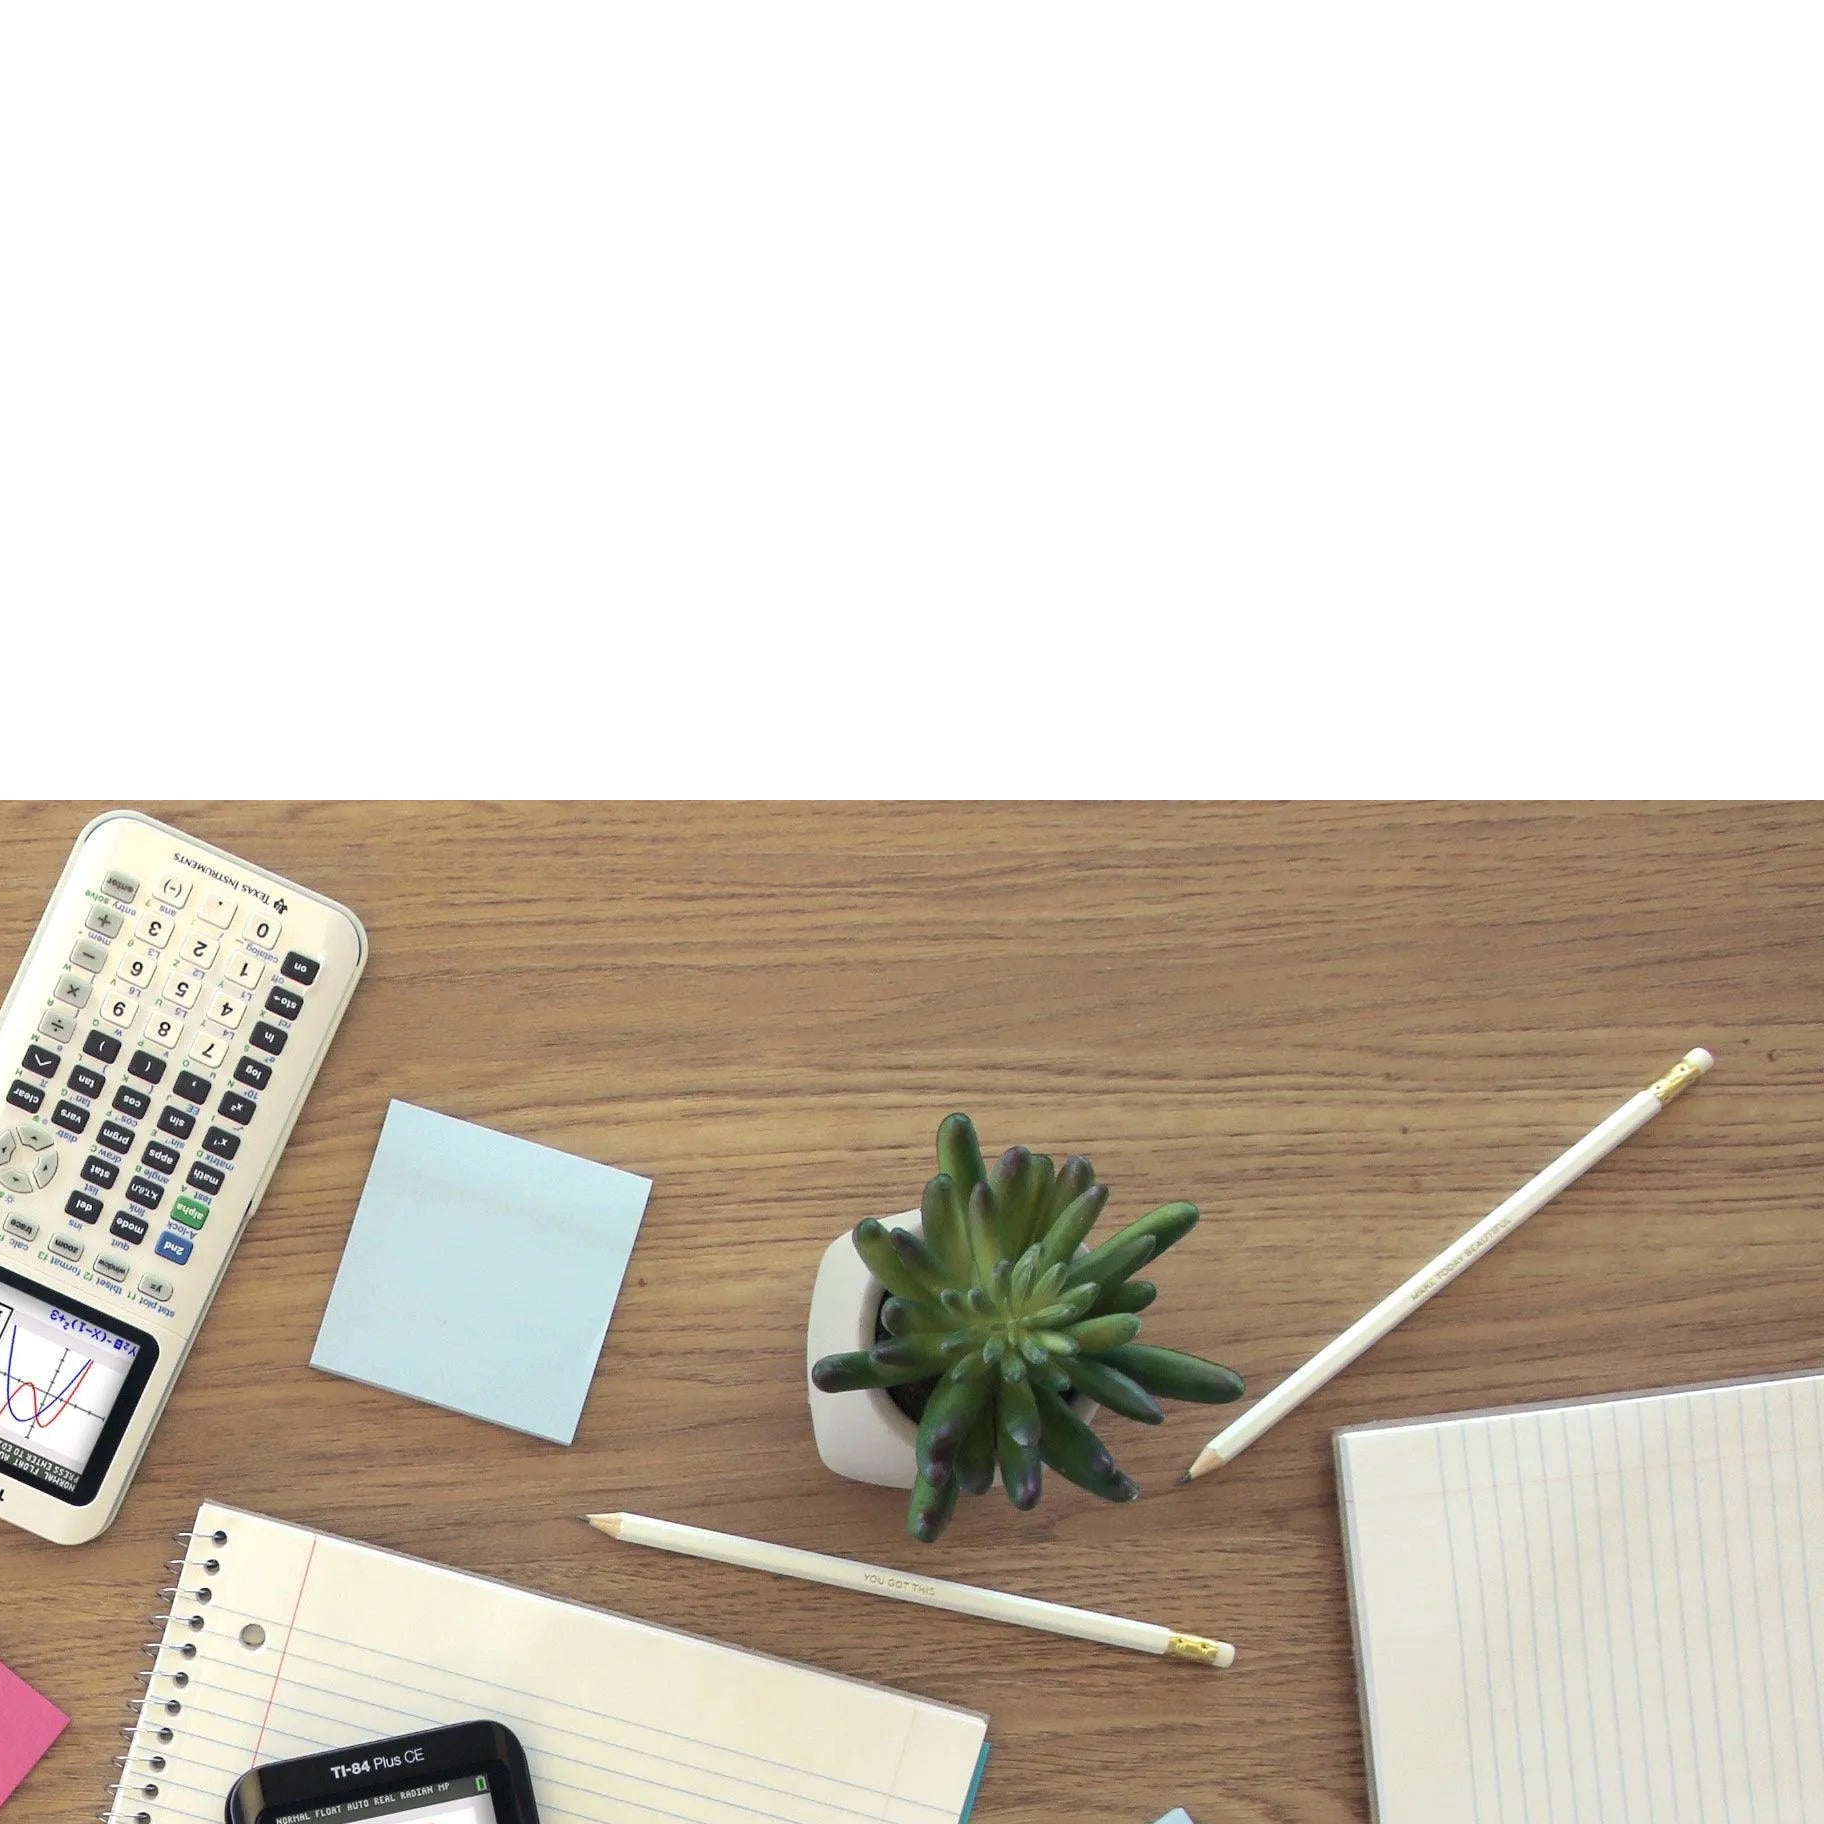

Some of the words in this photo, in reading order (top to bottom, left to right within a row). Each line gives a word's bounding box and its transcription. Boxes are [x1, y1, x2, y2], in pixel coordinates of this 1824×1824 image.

[173, 852, 239, 889] INSTRUMENTS
[241, 883, 269, 905] TEXAS
[148, 920, 161, 936] 3
[256, 922, 269, 937] 0
[192, 940, 207, 956] 2
[245, 942, 278, 963] catalog
[130, 961, 143, 976] 6
[239, 962, 248, 976] 1
[293, 962, 307, 972] on
[175, 981, 188, 997] 5
[112, 1001, 125, 1016] 9
[220, 1001, 233, 1016] 4
[157, 1021, 170, 1036] 8
[201, 1042, 214, 1058] 7
[245, 1064, 261, 1079] log
[78, 1074, 94, 1087] tan
[13, 1087, 39, 1103] clear
[122, 1094, 141, 1107] cos
[60, 1108, 81, 1123] vars
[169, 1114, 185, 1126] sin
[102, 1128, 129, 1144] prgm
[148, 1148, 173, 1164] apps
[89, 1164, 110, 1177] stat
[193, 1168, 218, 1185] math
[75, 1199, 92, 1211] del
[176, 1202, 203, 1219] alpha
[10, 1218, 32, 1234] trace
[116, 1217, 144, 1234] mode
[8, 1237, 28, 1250] calc
[54, 1238, 78, 1253] zoom
[163, 1240, 184, 1255] 2nd
[37, 1250, 48, 1260] f3
[49, 1255, 81, 1276] format
[97, 1258, 125, 1274] window
[82, 1271, 93, 1281] f2
[95, 1276, 122, 1294] tblset
[126, 1291, 136, 1300] f1
[138, 1296, 157, 1309] plot
[157, 1305, 175, 1317] stat
[12, 1447, 24, 1458] TO
[12, 1458, 39, 1474] FLOAT
[25, 1452, 52, 1470] ENTER
[44, 1470, 75, 1491] NORMAL
[52, 1465, 79, 1482] PRESS
[864, 1573, 884, 1585] YOU
[887, 1578, 909, 1590] GOT
[912, 1583, 936, 1596] THIS
[330, 1760, 370, 1778] TI-84
[373, 1755, 401, 1770] Plus
[404, 1747, 424, 1763] CE
[314, 1805, 341, 1818] FLOAT
[347, 1799, 369, 1811] AUTO
[373, 1794, 395, 1805] REAL
[400, 1785, 433, 1799] RADIAN
[437, 1782, 449, 1791] MP
